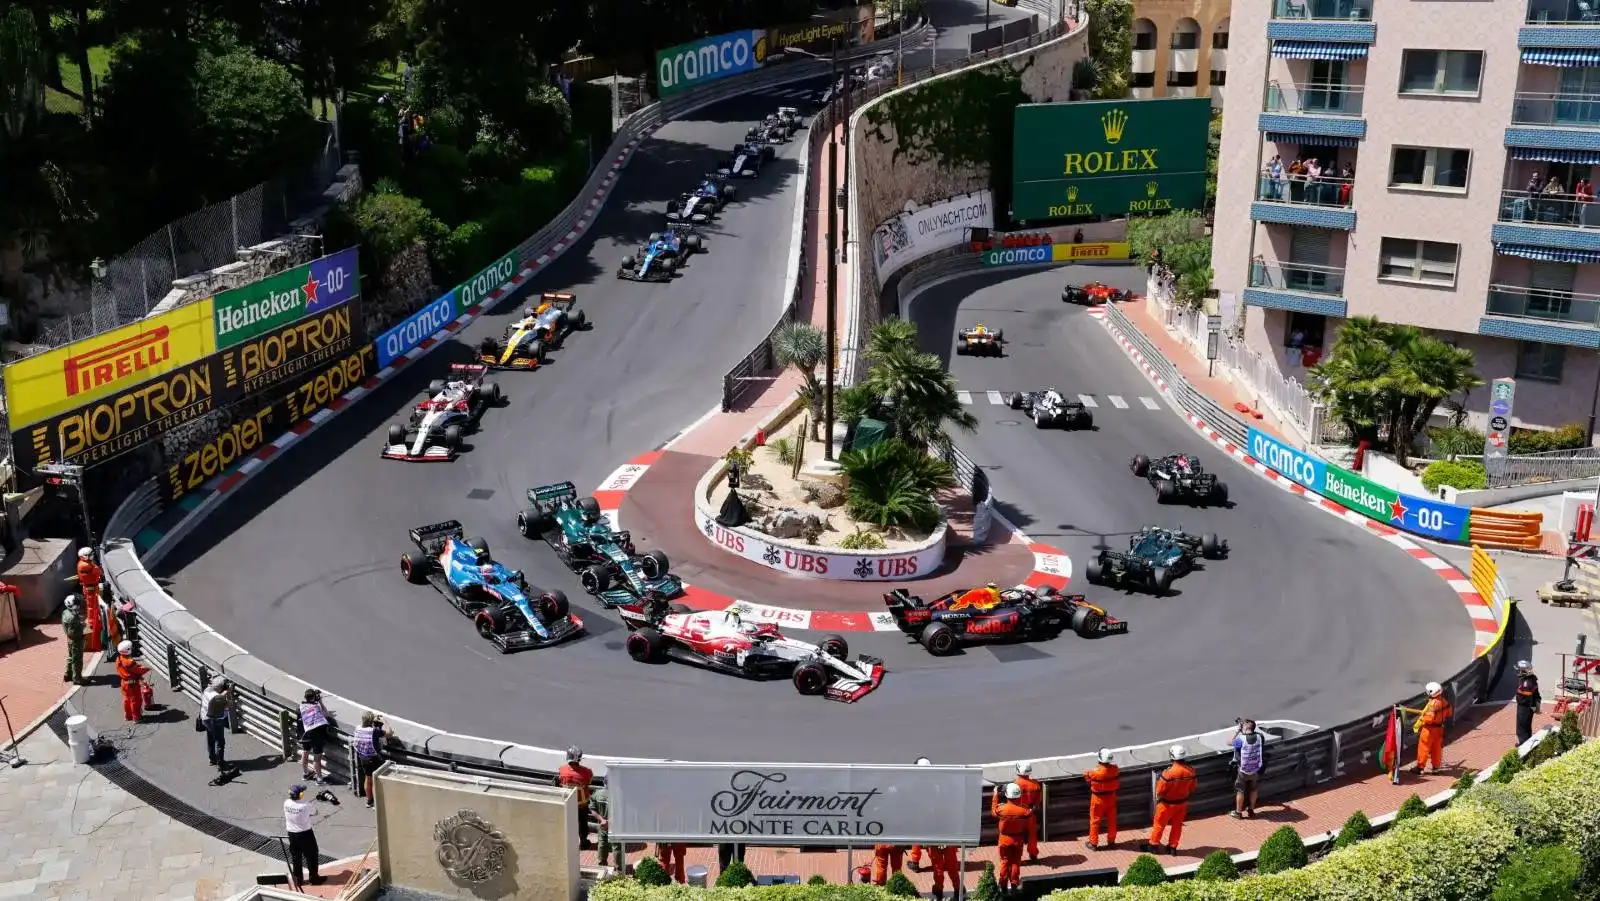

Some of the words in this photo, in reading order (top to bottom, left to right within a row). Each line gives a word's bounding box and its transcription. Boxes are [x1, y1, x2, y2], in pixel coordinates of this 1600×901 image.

[780, 26, 821, 46] HyperLight
[659, 37, 749, 88] aramco
[1063, 149, 1160, 175] ROLEX
[918, 203, 988, 236] ONLYYACHT.COM
[1049, 203, 1094, 217] ROLEX
[1129, 198, 1172, 212] ROLEX
[990, 246, 1046, 265] aramco
[1071, 245, 1110, 257] PIRELLI
[462, 256, 513, 306] aramco
[217, 288, 301, 335] Heineken
[386, 300, 450, 357] aramco
[241, 305, 351, 379] BIOPTRON
[64, 325, 169, 397] PIRELLI
[243, 358, 308, 393] HYPERLIGHT
[299, 344, 373, 415] zepter
[59, 363, 211, 458] BIOPTRON
[72, 428, 150, 465] YPERLIGHT
[157, 399, 213, 432] THERAPY
[184, 406, 272, 489] zepter
[1254, 435, 1315, 485] aramco
[1326, 471, 1386, 515] Heineken
[715, 527, 745, 553] UBS
[784, 551, 829, 574] UBS
[878, 556, 918, 577] UBS
[761, 609, 805, 623] UBS
[941, 612, 972, 620] HONDA
[711, 770, 883, 817] Fairmont
[709, 820, 793, 835] MONTE
[803, 820, 884, 836] CARLO
